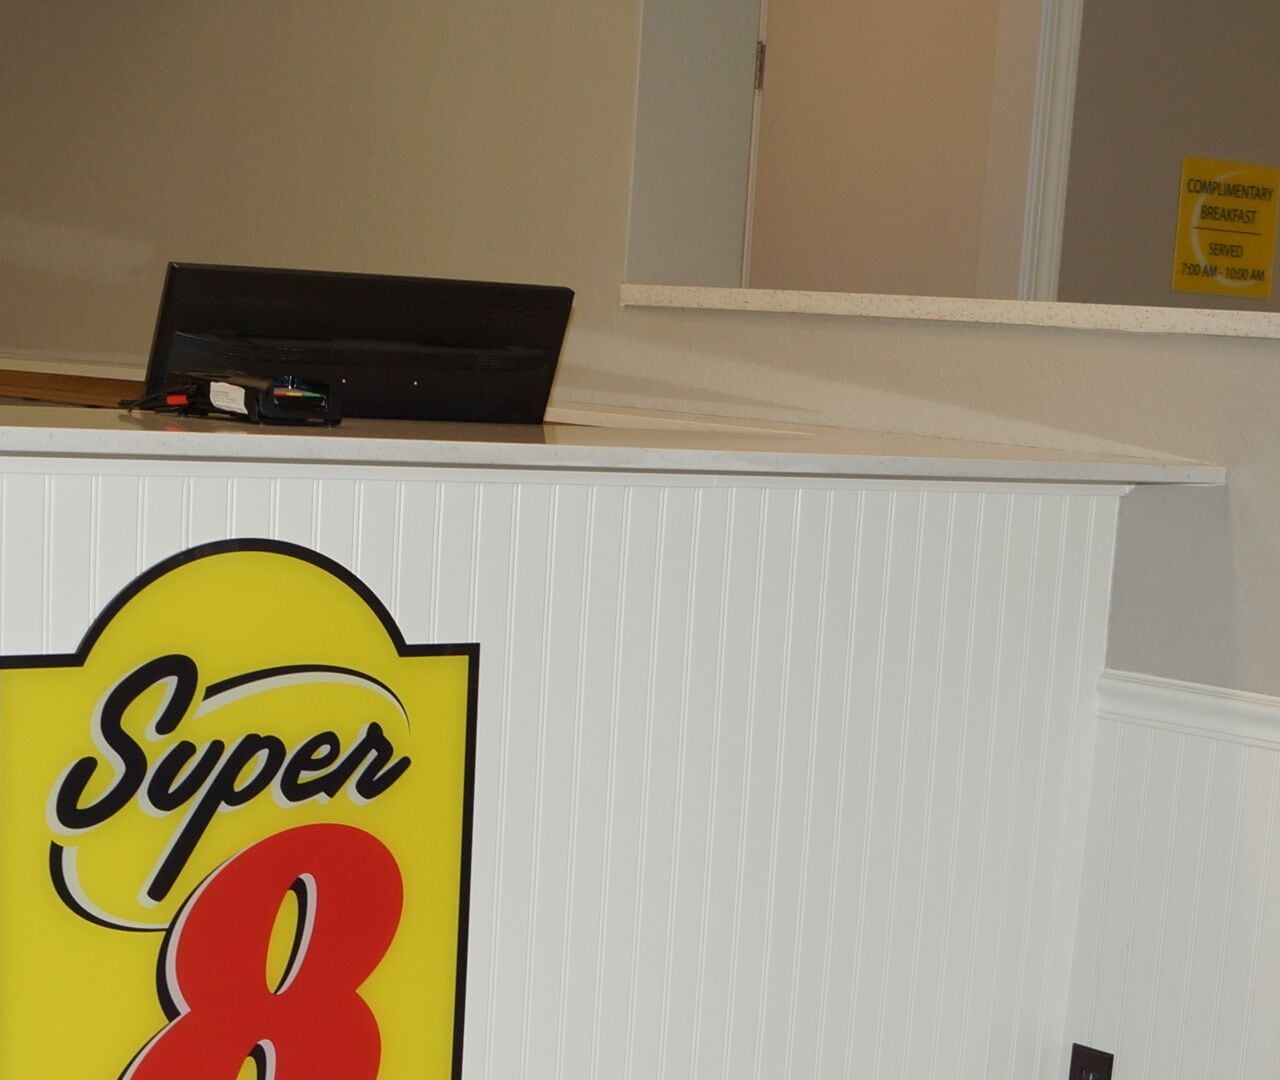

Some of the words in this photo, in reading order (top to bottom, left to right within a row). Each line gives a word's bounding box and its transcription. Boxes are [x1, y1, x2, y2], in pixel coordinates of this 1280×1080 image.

[1187, 178, 1274, 201] COMPLIMENTARY
[1200, 204, 1257, 224] BREAKFAST
[1208, 242, 1243, 258] SERVED
[56, 654, 411, 905] Super
